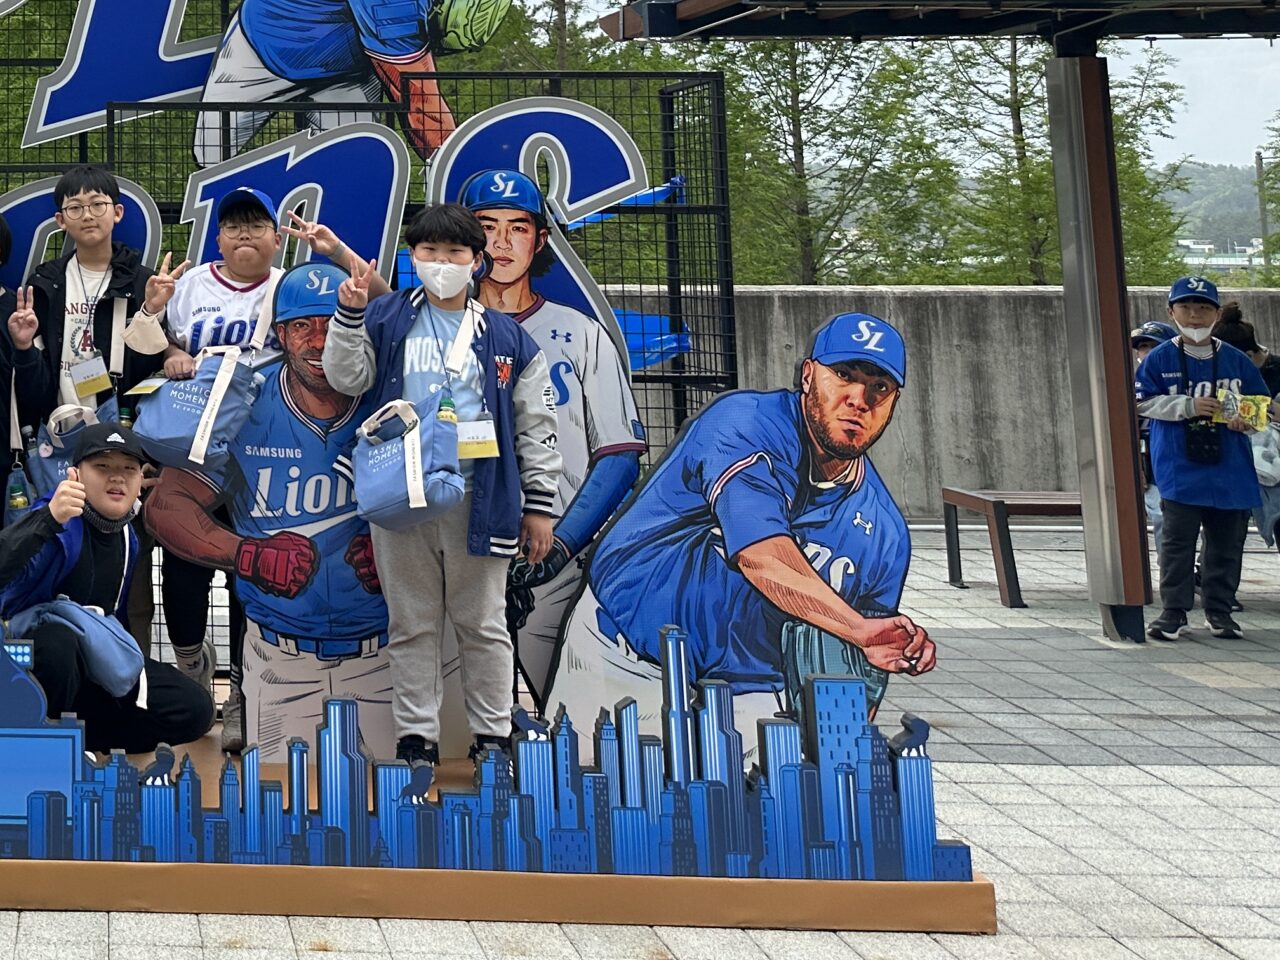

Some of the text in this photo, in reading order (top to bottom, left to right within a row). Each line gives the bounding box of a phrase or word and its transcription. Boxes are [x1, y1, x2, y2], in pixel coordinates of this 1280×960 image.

[490, 172, 519, 198] SL
[306, 269, 335, 295] SL
[1187, 276, 1207, 292] SL
[851, 320, 885, 352] SL
[170, 389, 206, 406] MOMEN
[245, 445, 302, 458] SAMSUNG
[368, 443, 397, 458] FASHI
[368, 443, 403, 467] MOMENT
